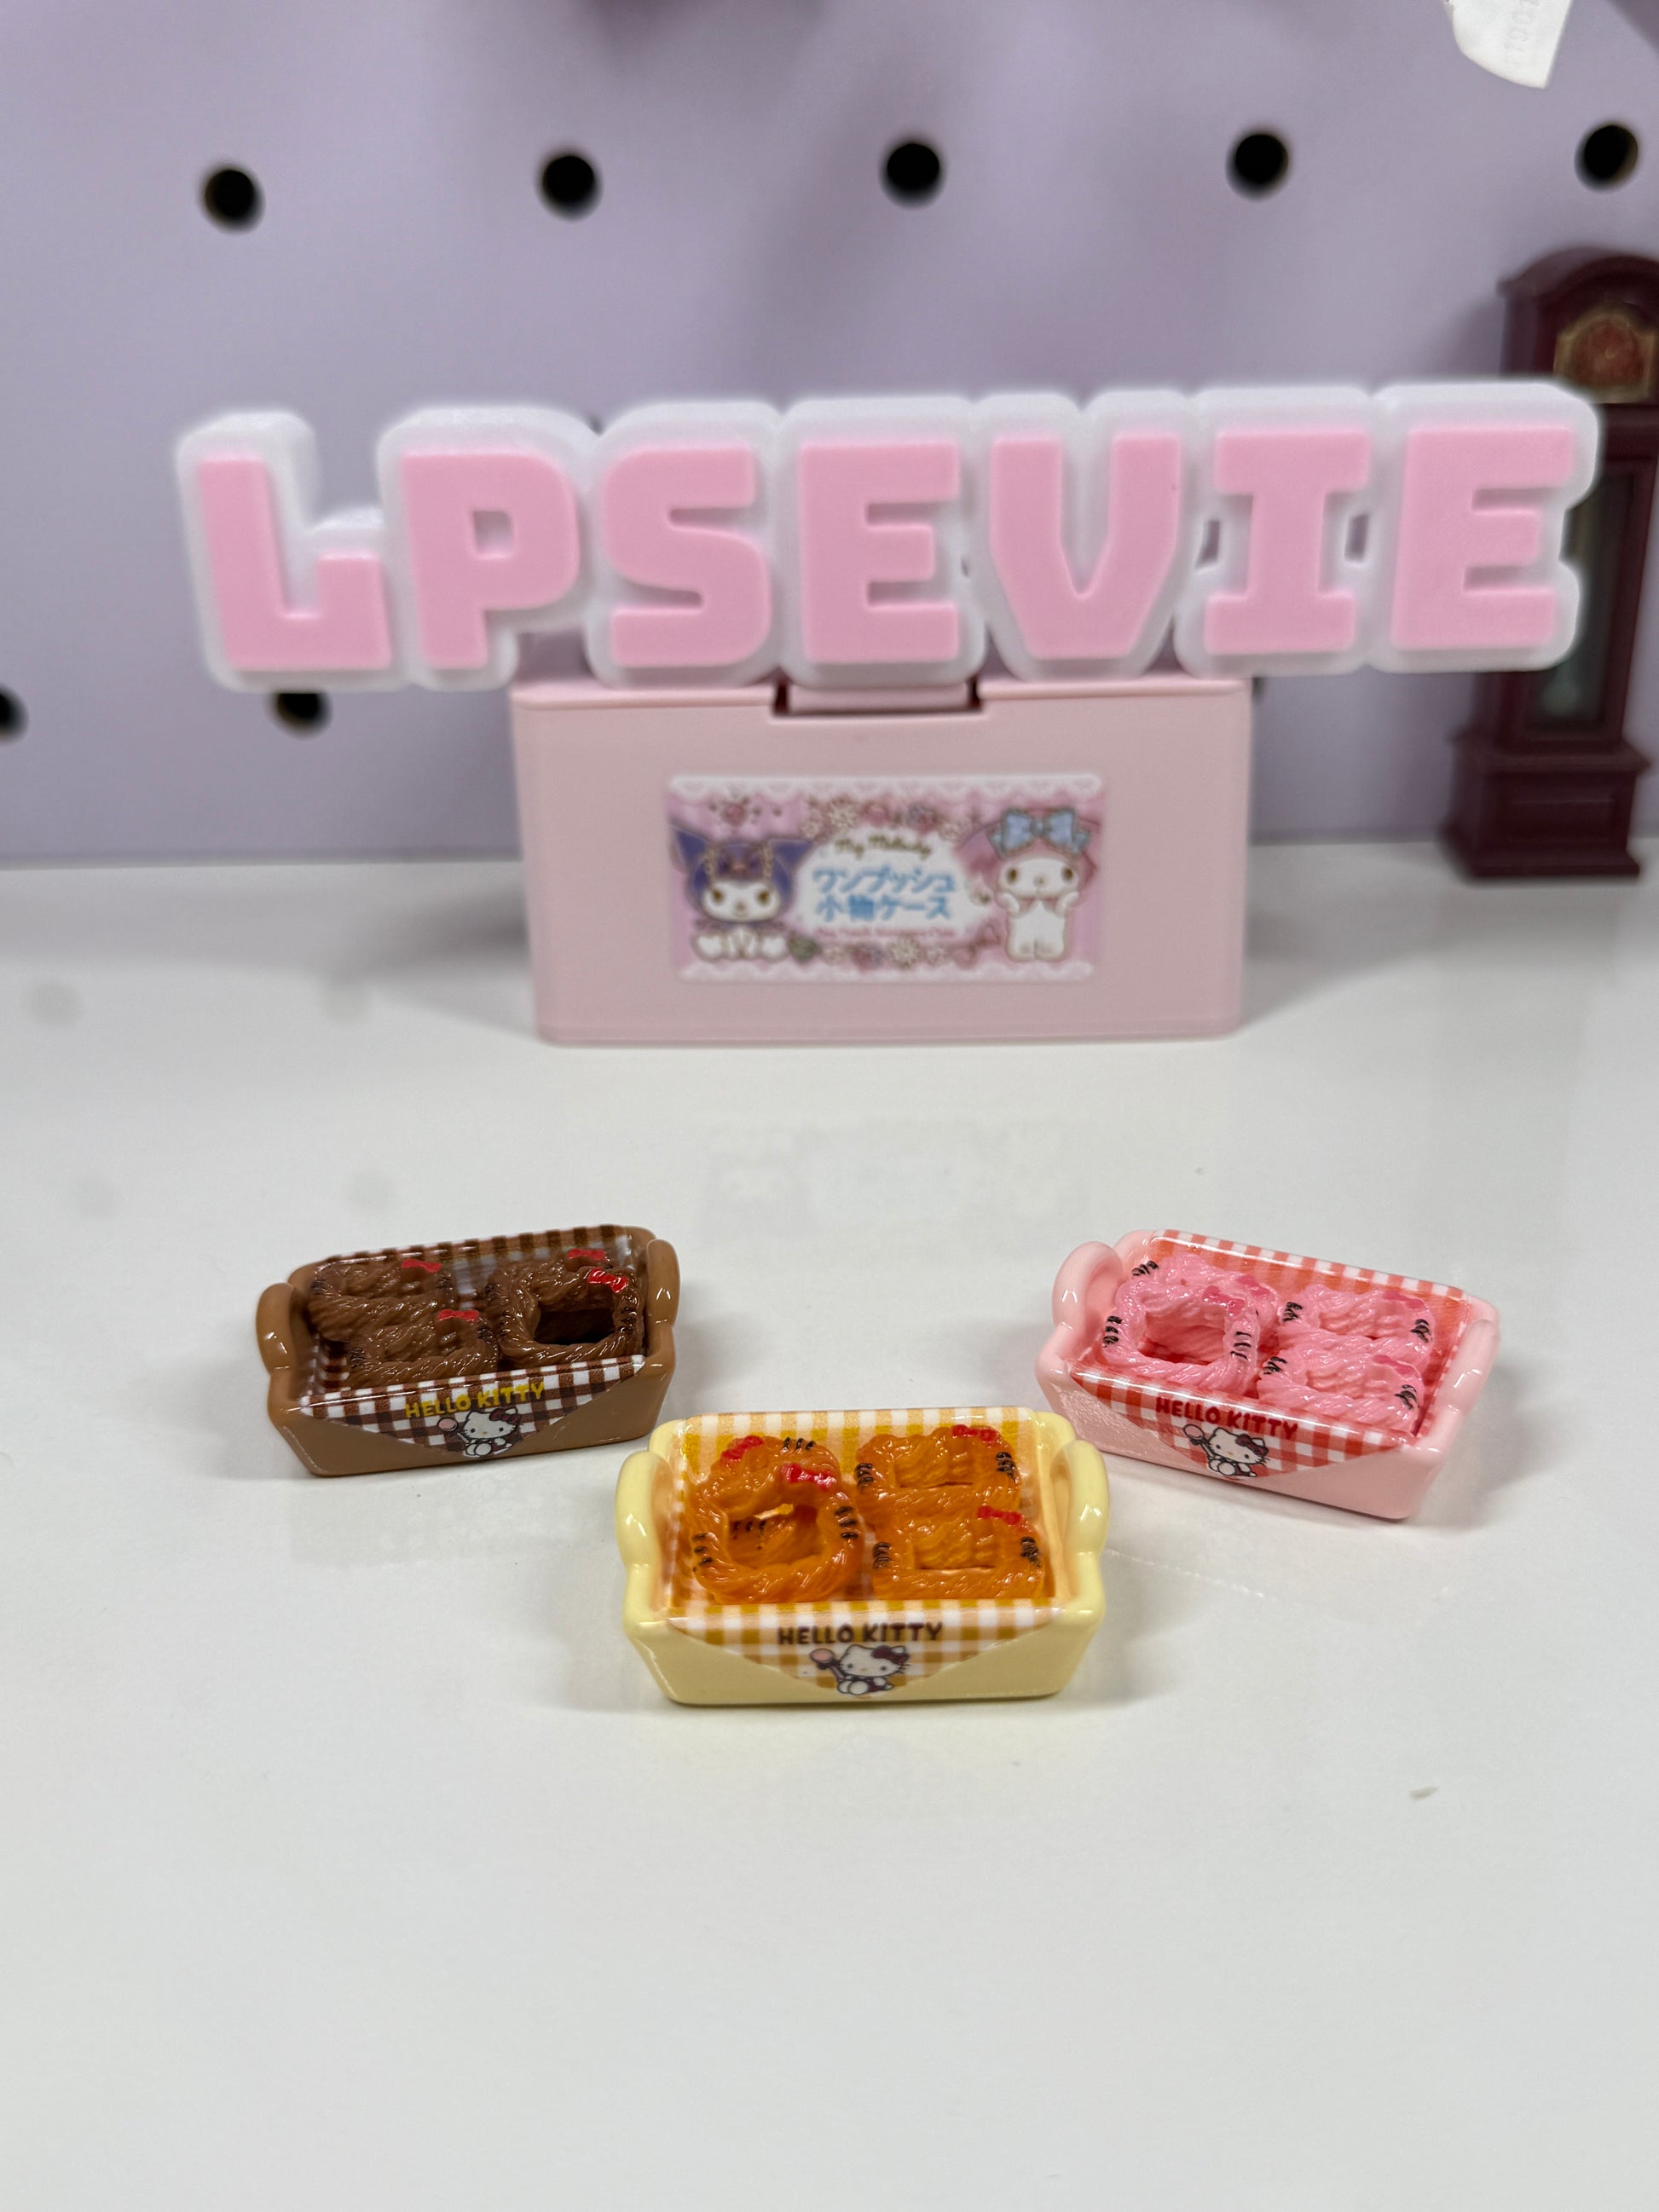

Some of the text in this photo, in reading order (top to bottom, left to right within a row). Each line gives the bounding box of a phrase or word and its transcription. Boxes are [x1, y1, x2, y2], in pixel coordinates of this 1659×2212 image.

[195, 426, 1575, 670] LPSEVIE
[405, 1381, 545, 1418] HELLO KITTY
[1155, 1396, 1298, 1440] HELLO KITTY
[777, 1622, 943, 1644] HELLO KITTY
